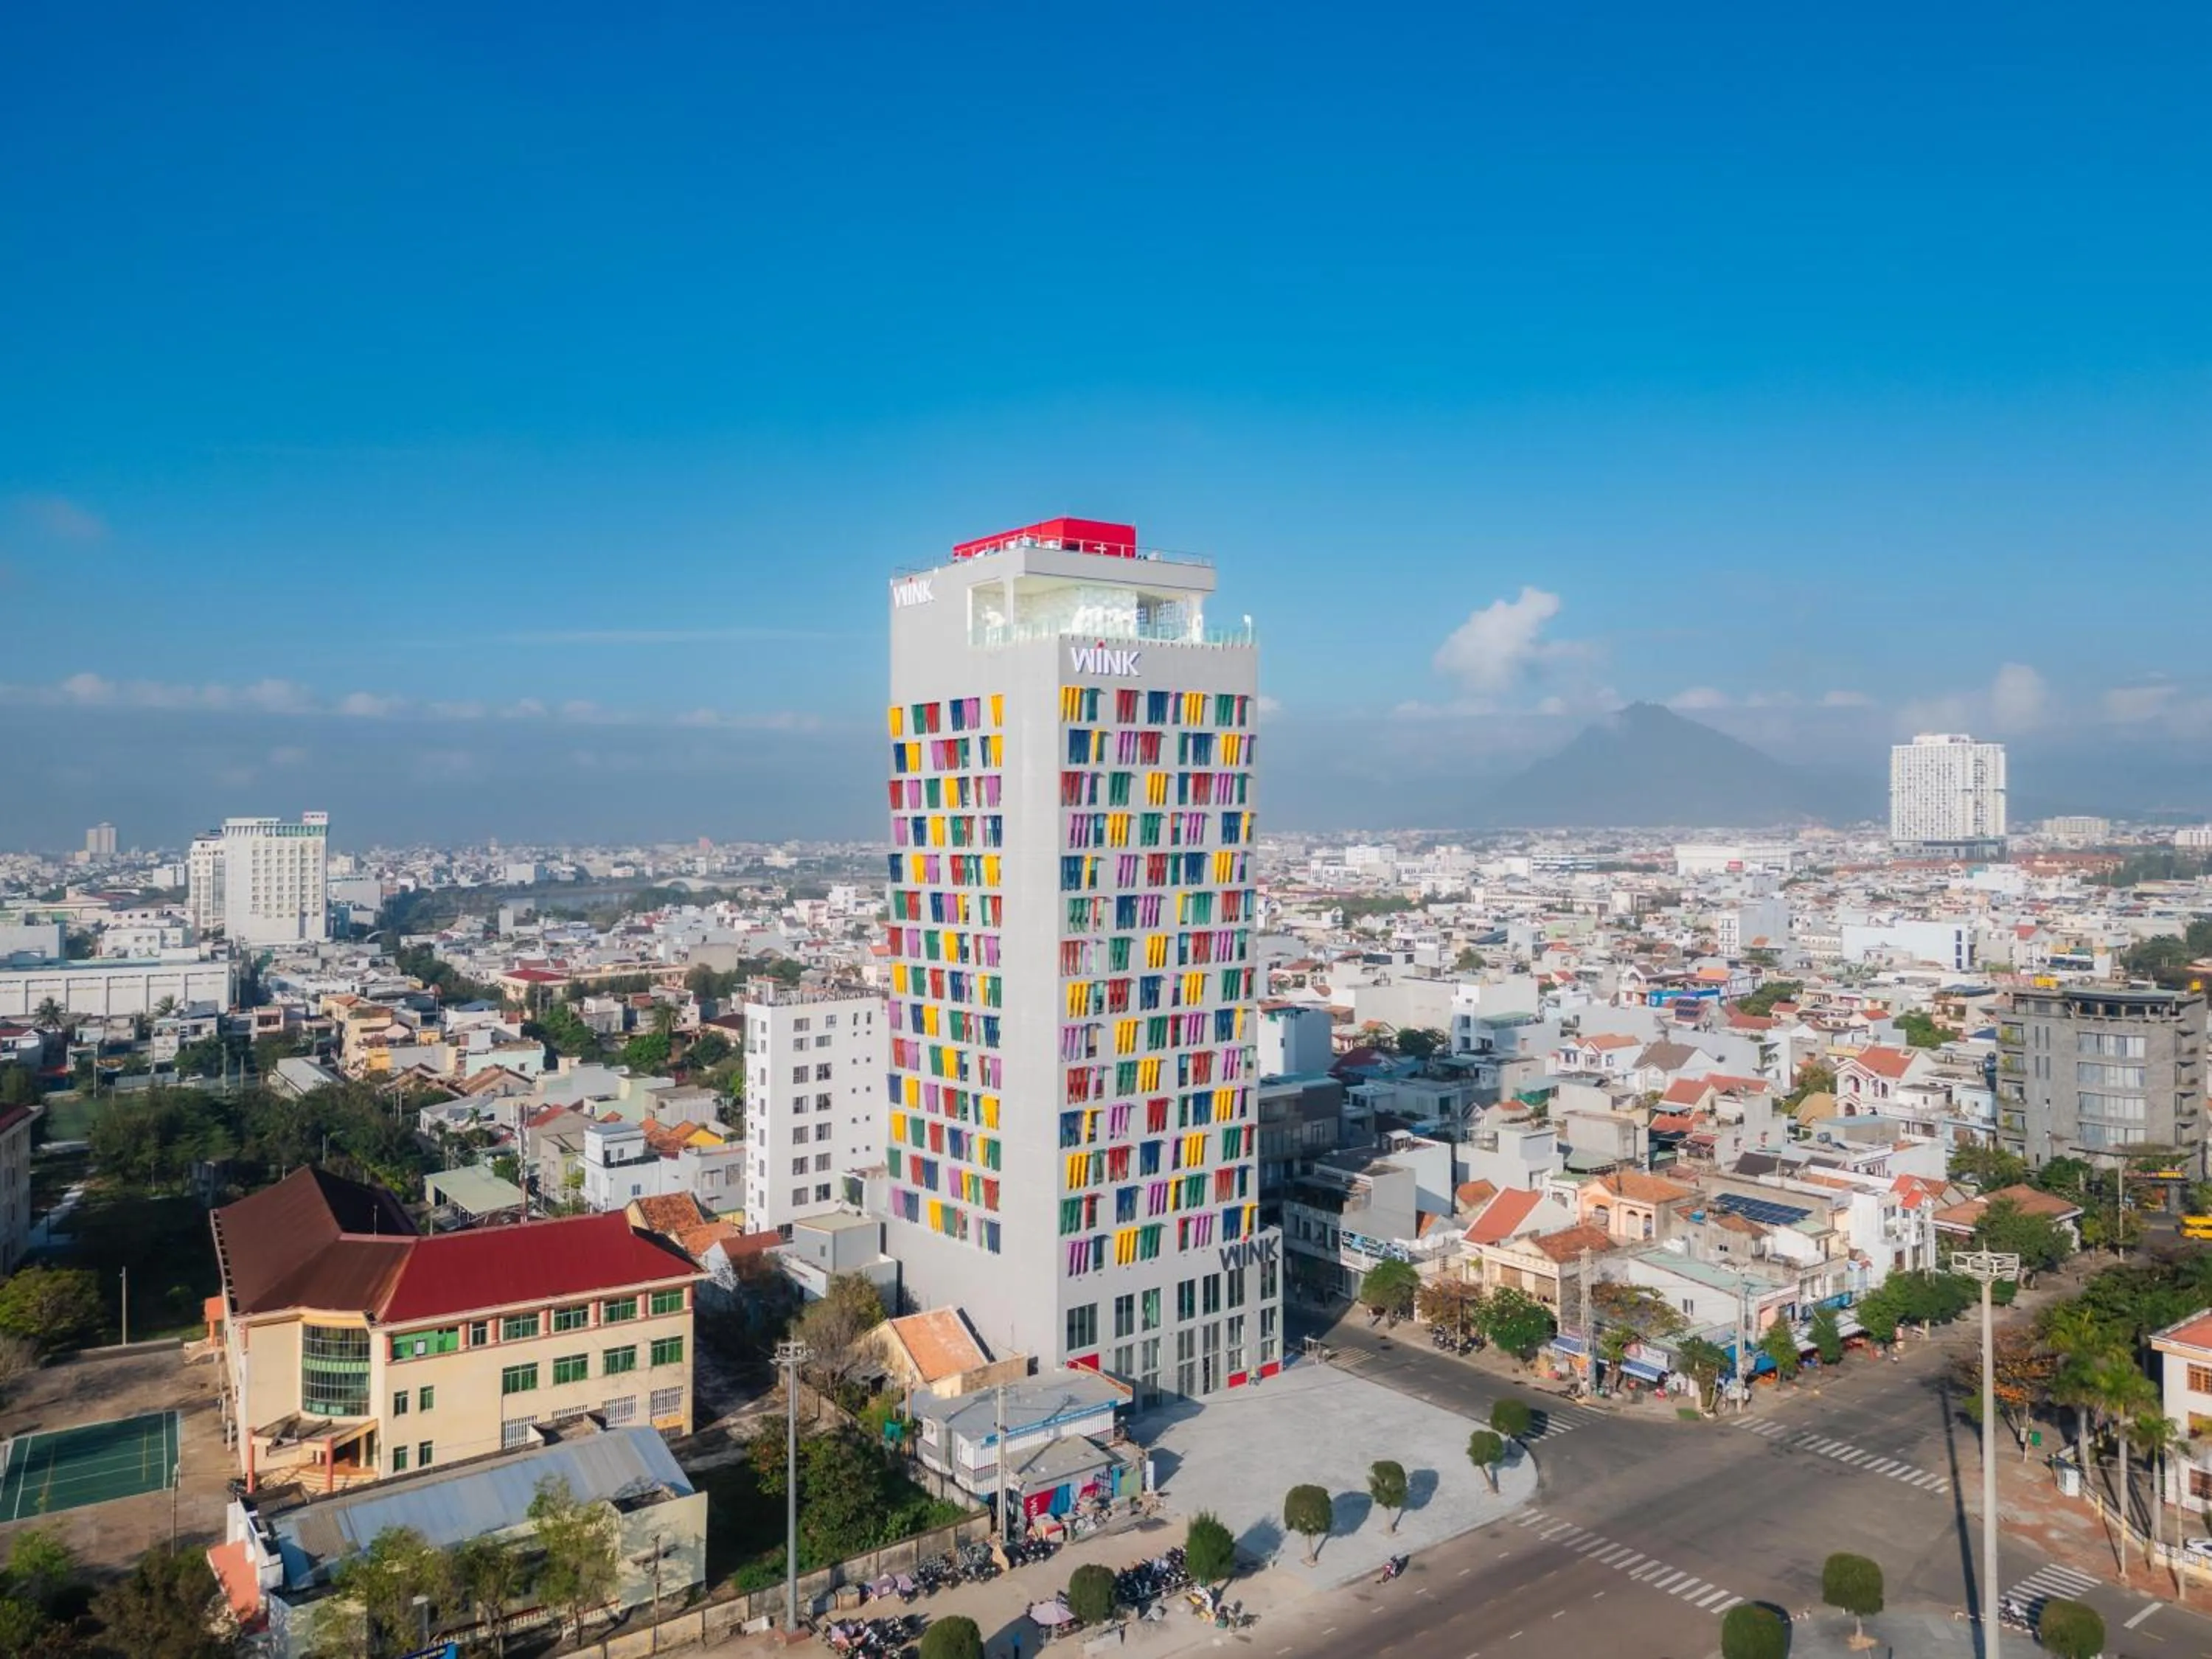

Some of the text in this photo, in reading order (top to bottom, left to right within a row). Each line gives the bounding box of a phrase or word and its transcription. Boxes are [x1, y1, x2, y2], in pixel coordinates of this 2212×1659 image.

[893, 577, 936, 608] WINK
[1070, 641, 1142, 678] WINK
[1219, 1234, 1280, 1271] WINK
